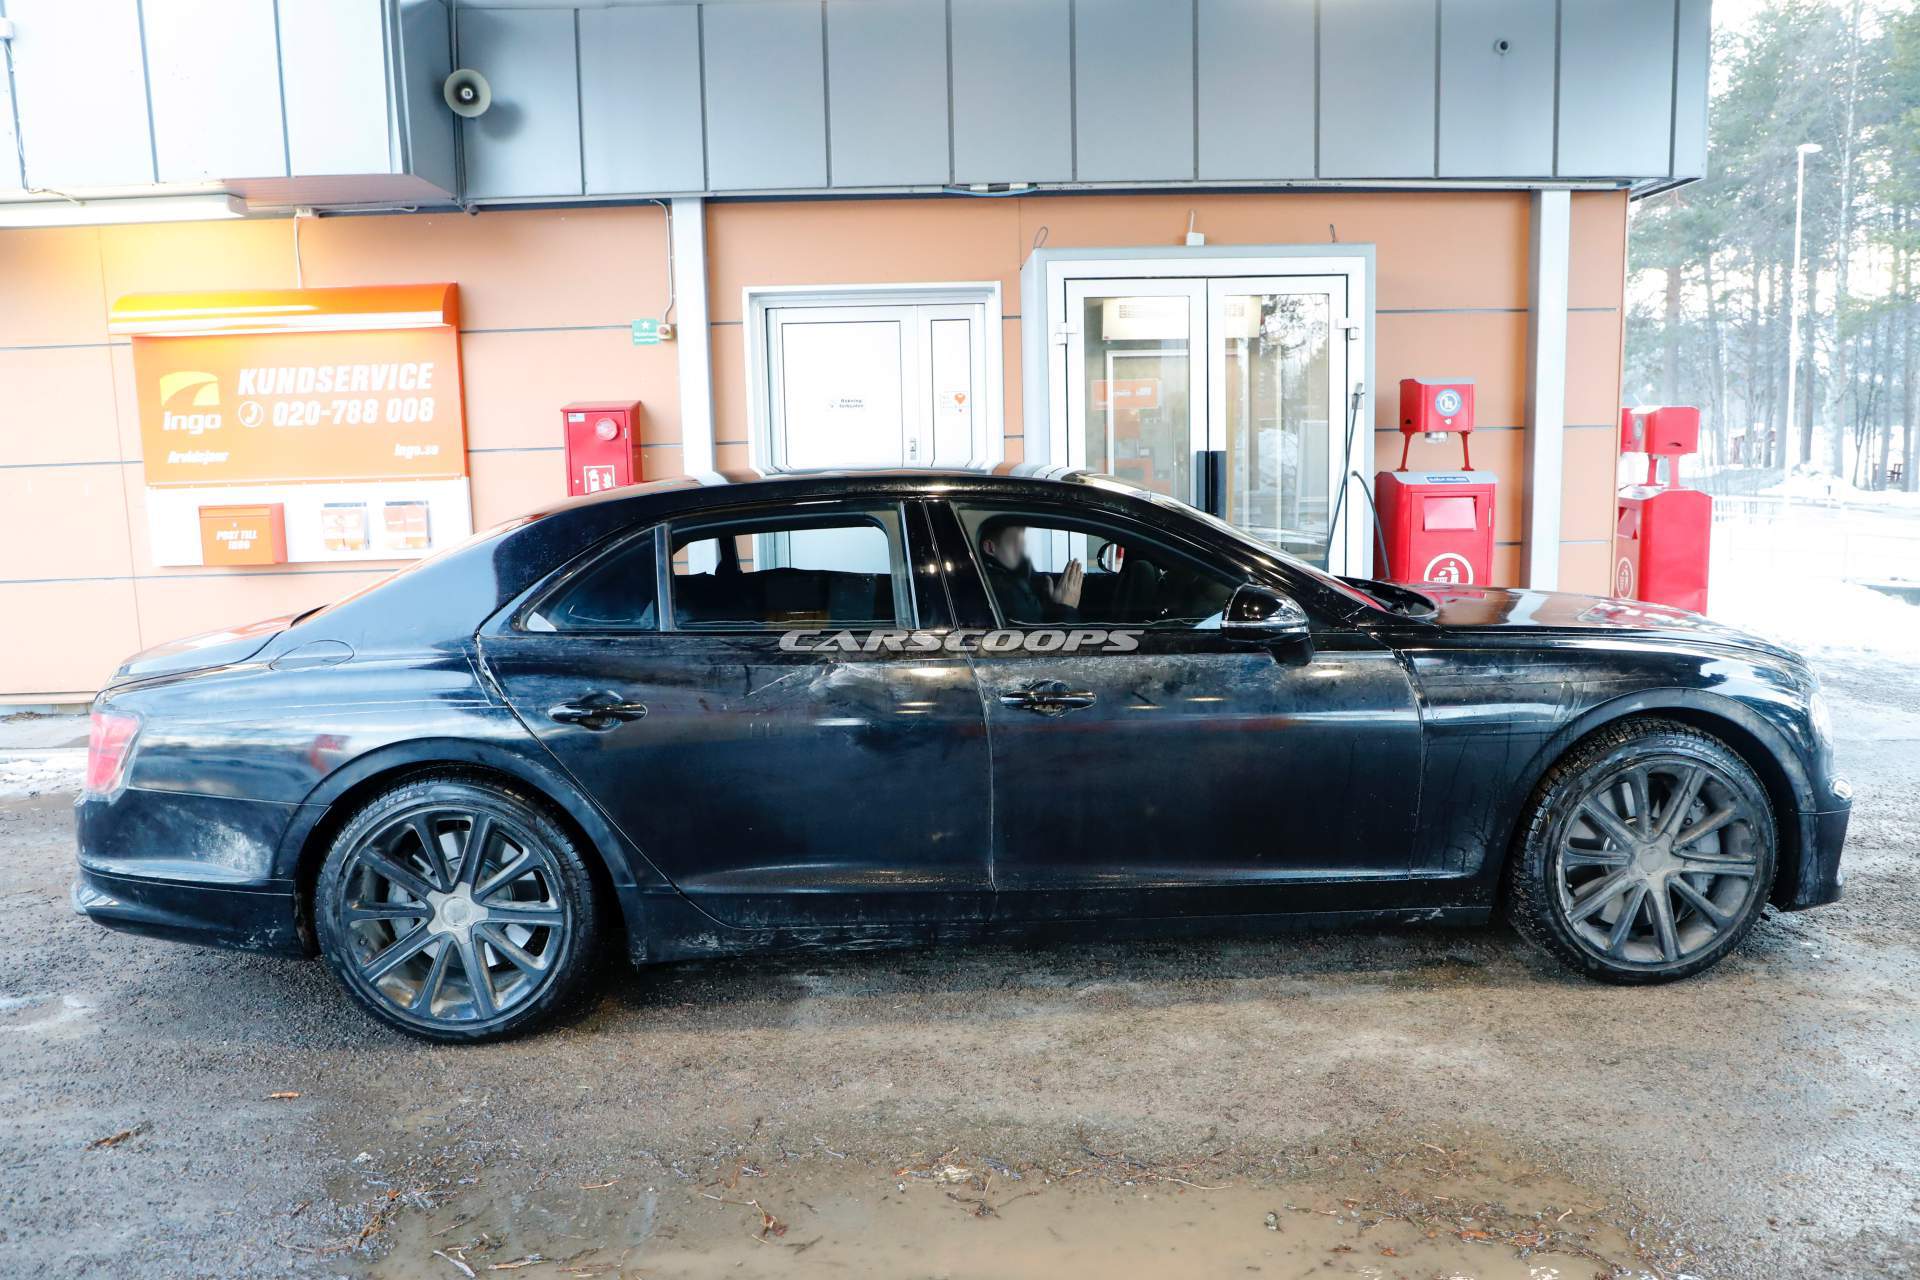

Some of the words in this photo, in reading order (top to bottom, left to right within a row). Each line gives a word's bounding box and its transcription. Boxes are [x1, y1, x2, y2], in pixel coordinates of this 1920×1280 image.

[239, 363, 433, 395] KUNDSERVICE
[163, 411, 222, 435] ingo
[273, 399, 378, 426] 020-788
[386, 397, 434, 422] 008
